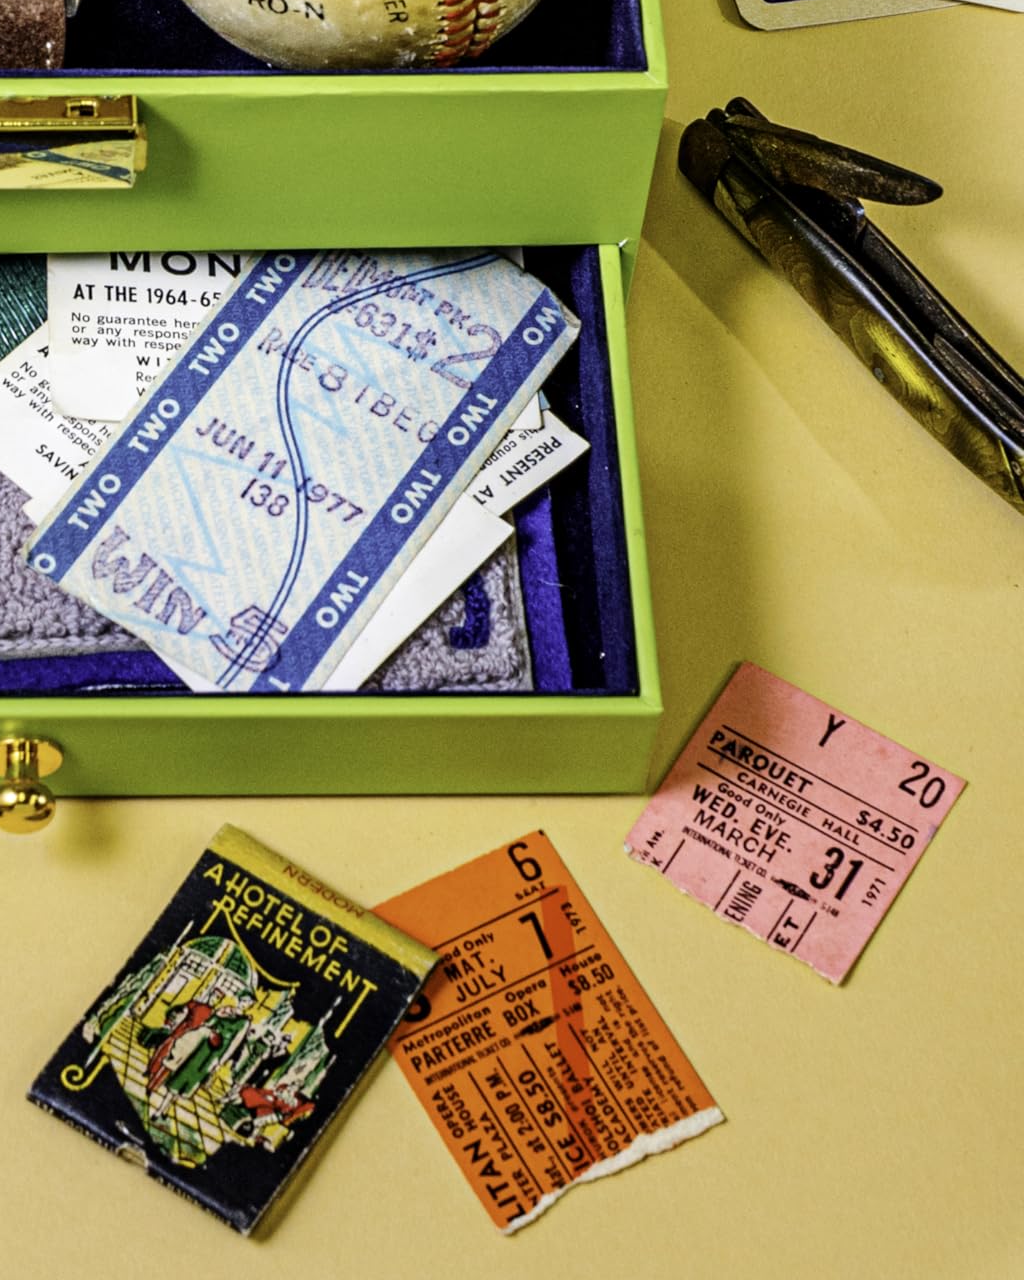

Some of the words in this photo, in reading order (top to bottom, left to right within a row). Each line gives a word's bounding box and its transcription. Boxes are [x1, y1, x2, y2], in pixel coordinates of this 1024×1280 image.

[73, 283, 96, 301] AT
[104, 285, 138, 303] THE
[71, 311, 91, 323] No
[97, 314, 168, 328] guarantee
[71, 324, 86, 334] or
[97, 325, 123, 338] any
[71, 336, 99, 348] way
[106, 331, 136, 348] with
[11, 371, 24, 382] or
[29, 386, 51, 404] any
[19, 361, 38, 378] No
[68, 472, 122, 532] TWO
[128, 397, 181, 455] TWO
[187, 320, 241, 377] TWO
[246, 254, 297, 306] TWO
[317, 364, 348, 393] 8
[2, 378, 26, 398] way
[29, 400, 54, 422] with
[446, 392, 499, 447] TWO
[35, 444, 79, 480] SAVIN
[195, 418, 256, 460] JUN
[257, 451, 288, 481] 11
[296, 477, 364, 523] 1977
[500, 436, 562, 486] PRESENT
[240, 478, 290, 517] 138
[390, 468, 443, 524] TWO
[91, 525, 208, 636] WIN
[315, 570, 369, 629] TWO
[818, 714, 846, 747] Y
[708, 729, 813, 793] PARQUET
[856, 810, 915, 850] $4.50
[717, 782, 753, 808] Good
[755, 804, 786, 826] Only
[898, 760, 946, 808] 20
[692, 784, 738, 823] WED.
[750, 818, 792, 853] EVE.
[736, 771, 810, 818] CARNEGIE
[822, 818, 859, 846] HALL
[693, 808, 777, 863] MARCH
[507, 842, 542, 882] 6
[809, 847, 864, 901] 31
[203, 863, 224, 886] A
[223, 872, 303, 935] HOTEL
[310, 925, 348, 954] OF
[278, 862, 368, 920] MODERN
[724, 880, 762, 922] ENING
[861, 878, 886, 906] 1971
[463, 933, 494, 951] Only
[518, 912, 554, 960] 7
[200, 894, 379, 1040] REFINEMENT
[440, 951, 494, 983] MAT.
[456, 964, 506, 1003] JULY
[402, 1006, 491, 1054] Metropolitan
[504, 979, 547, 1003] Opera
[558, 953, 602, 978] House
[410, 1020, 496, 1073] PARTERRE
[502, 999, 540, 1027] BOX
[568, 964, 614, 995] $8.50
[485, 1068, 512, 1101] P.M.
[544, 1040, 583, 1095] BALLET
[432, 1088, 464, 1139] OPERA
[442, 1084, 478, 1132] HOUSE
[505, 1103, 534, 1136] 2:00
[518, 1063, 562, 1128] $8.50
[582, 1069, 635, 1149] ACADEMY
[479, 1107, 513, 1162] PLAZA
[527, 1136, 546, 1153] at
[557, 1133, 591, 1172] ICE
[463, 1139, 526, 1223] LITAN
